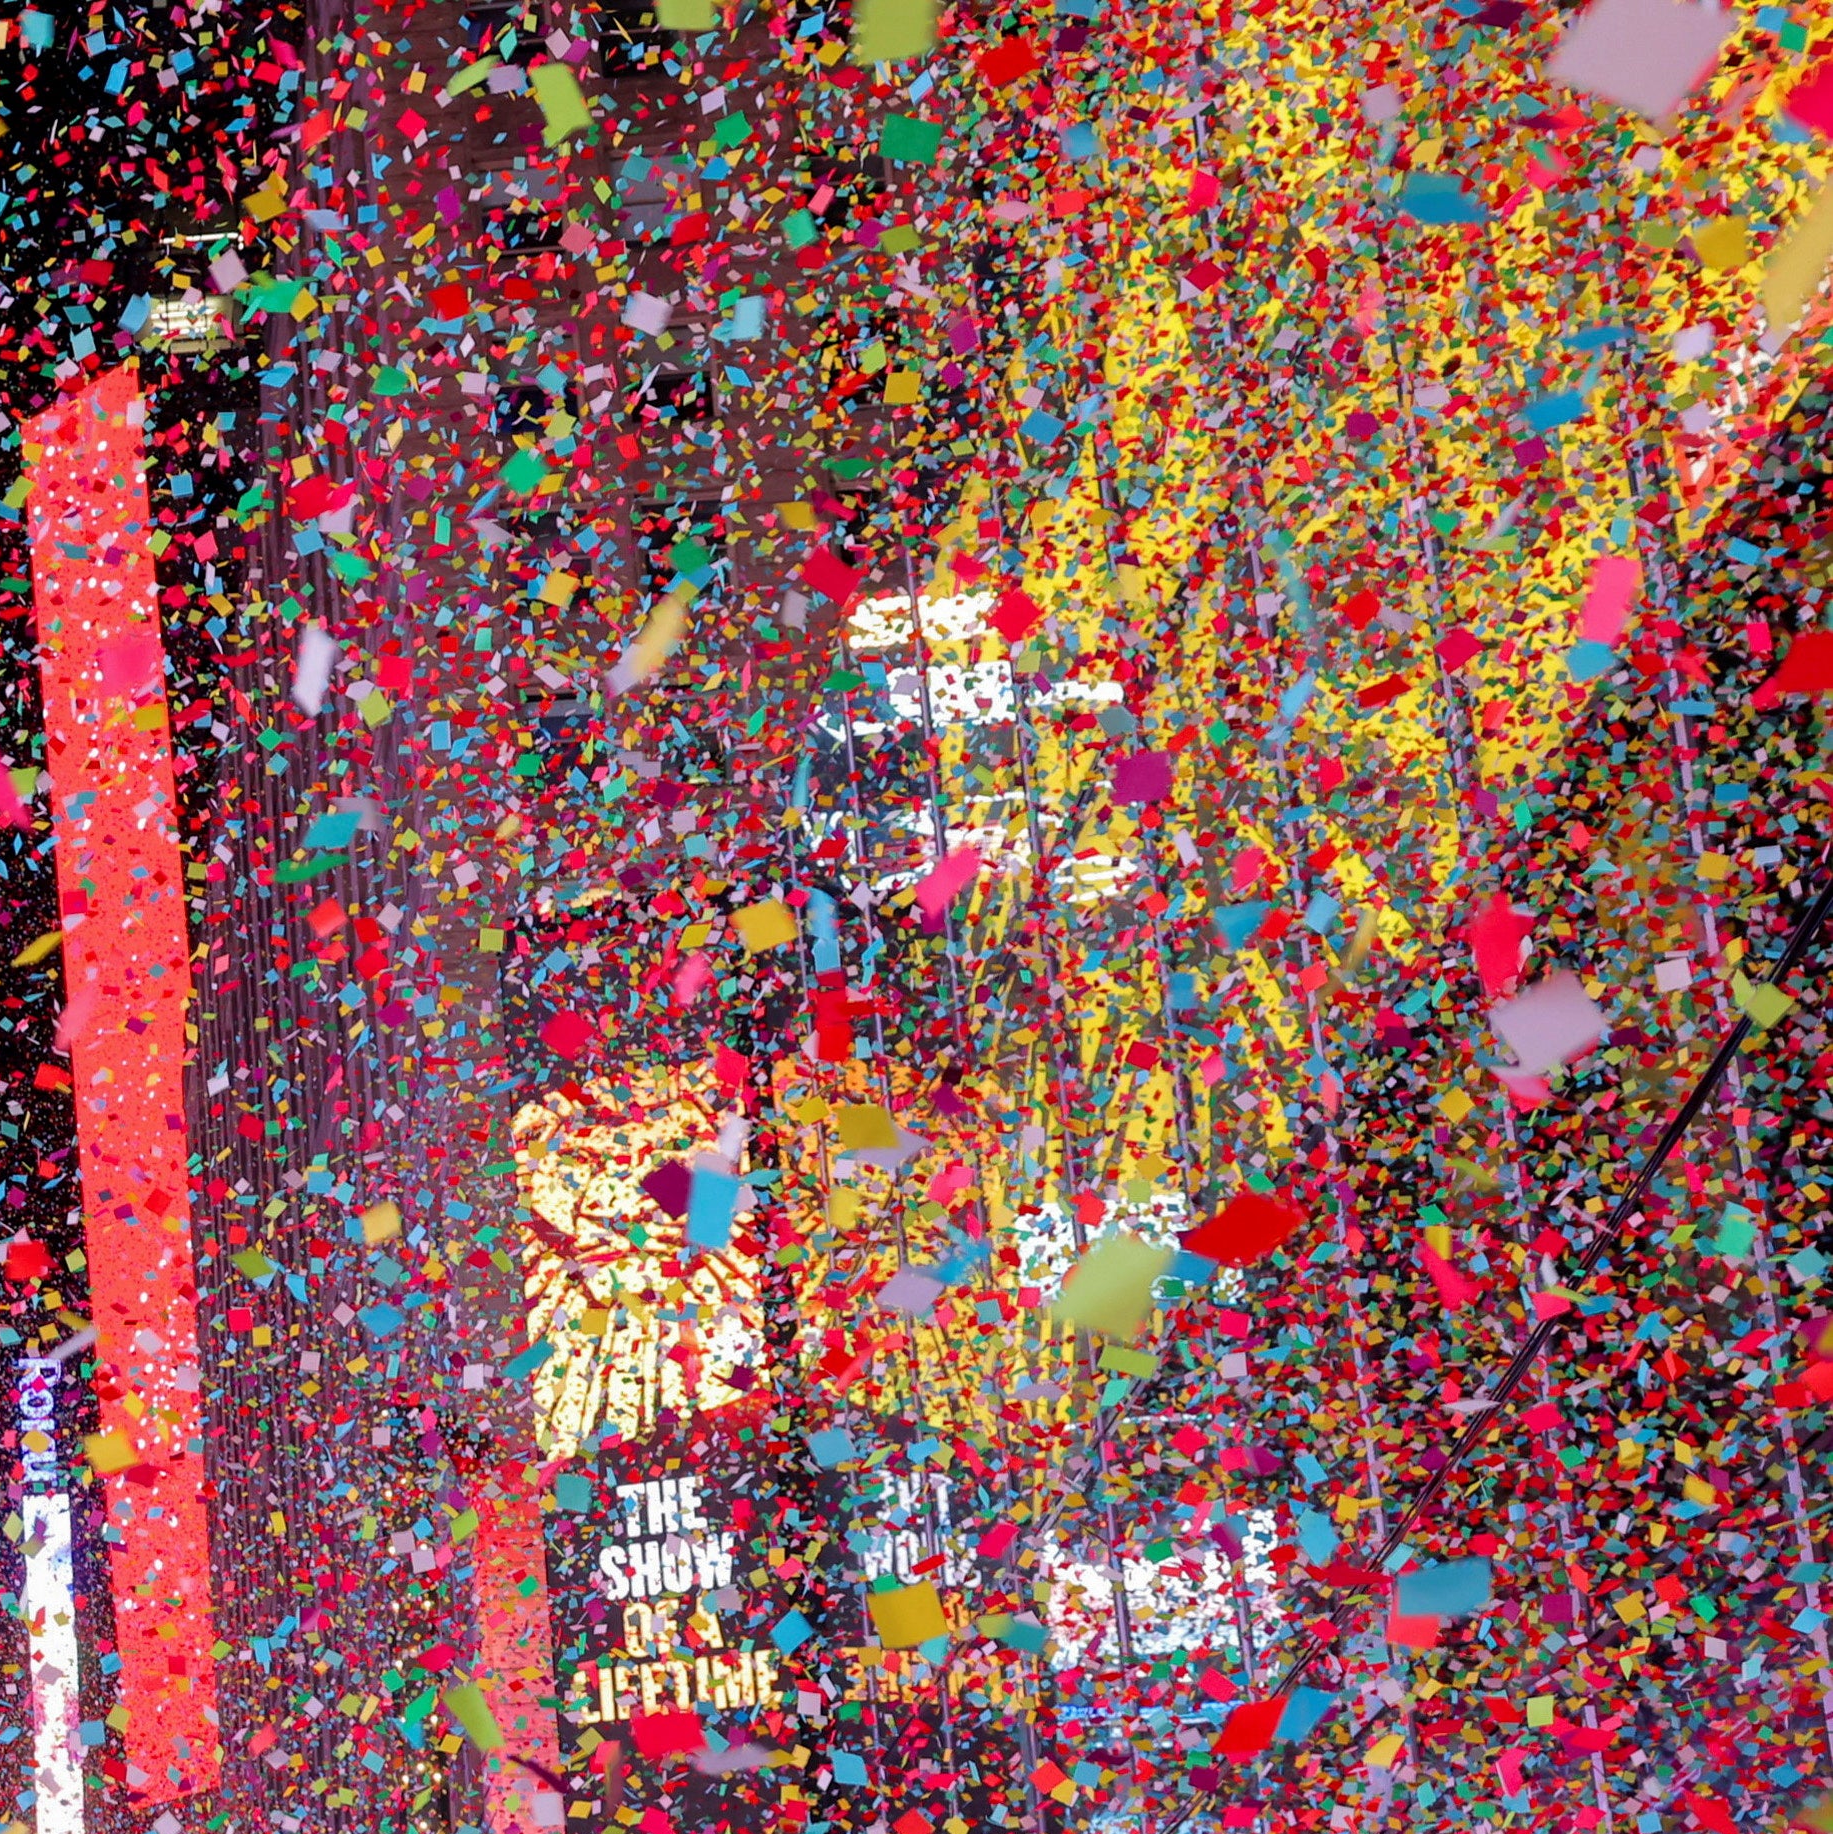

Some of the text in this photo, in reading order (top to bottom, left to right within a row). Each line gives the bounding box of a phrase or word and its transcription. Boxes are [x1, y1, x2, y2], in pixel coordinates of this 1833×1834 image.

[617, 1476, 708, 1538] THE
[598, 1535, 733, 1600] SHOW
[573, 1647, 783, 1725] LIFETIME
